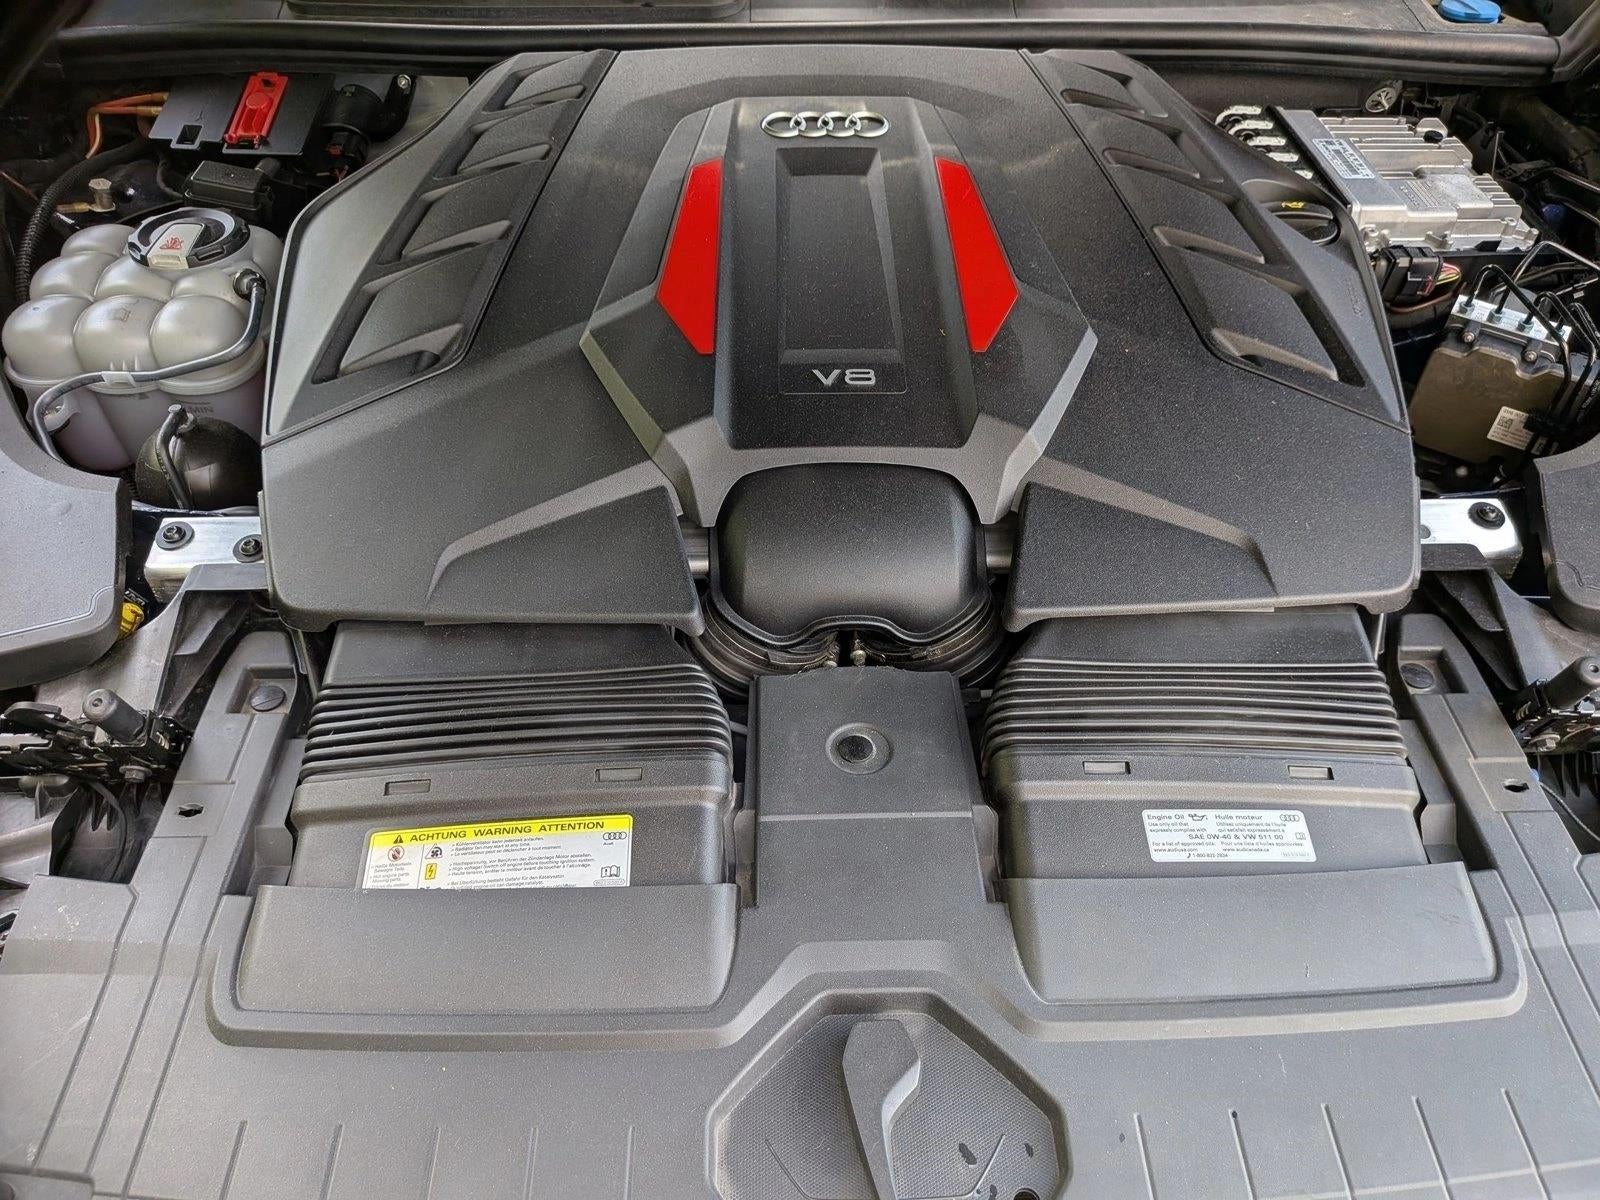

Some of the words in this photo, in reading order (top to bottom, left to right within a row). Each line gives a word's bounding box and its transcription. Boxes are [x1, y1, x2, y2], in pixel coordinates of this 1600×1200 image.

[812, 369, 876, 386] V8
[410, 831, 467, 842] ACHTUNG
[473, 826, 532, 837] WARNING
[538, 821, 605, 833] ATTENTION
